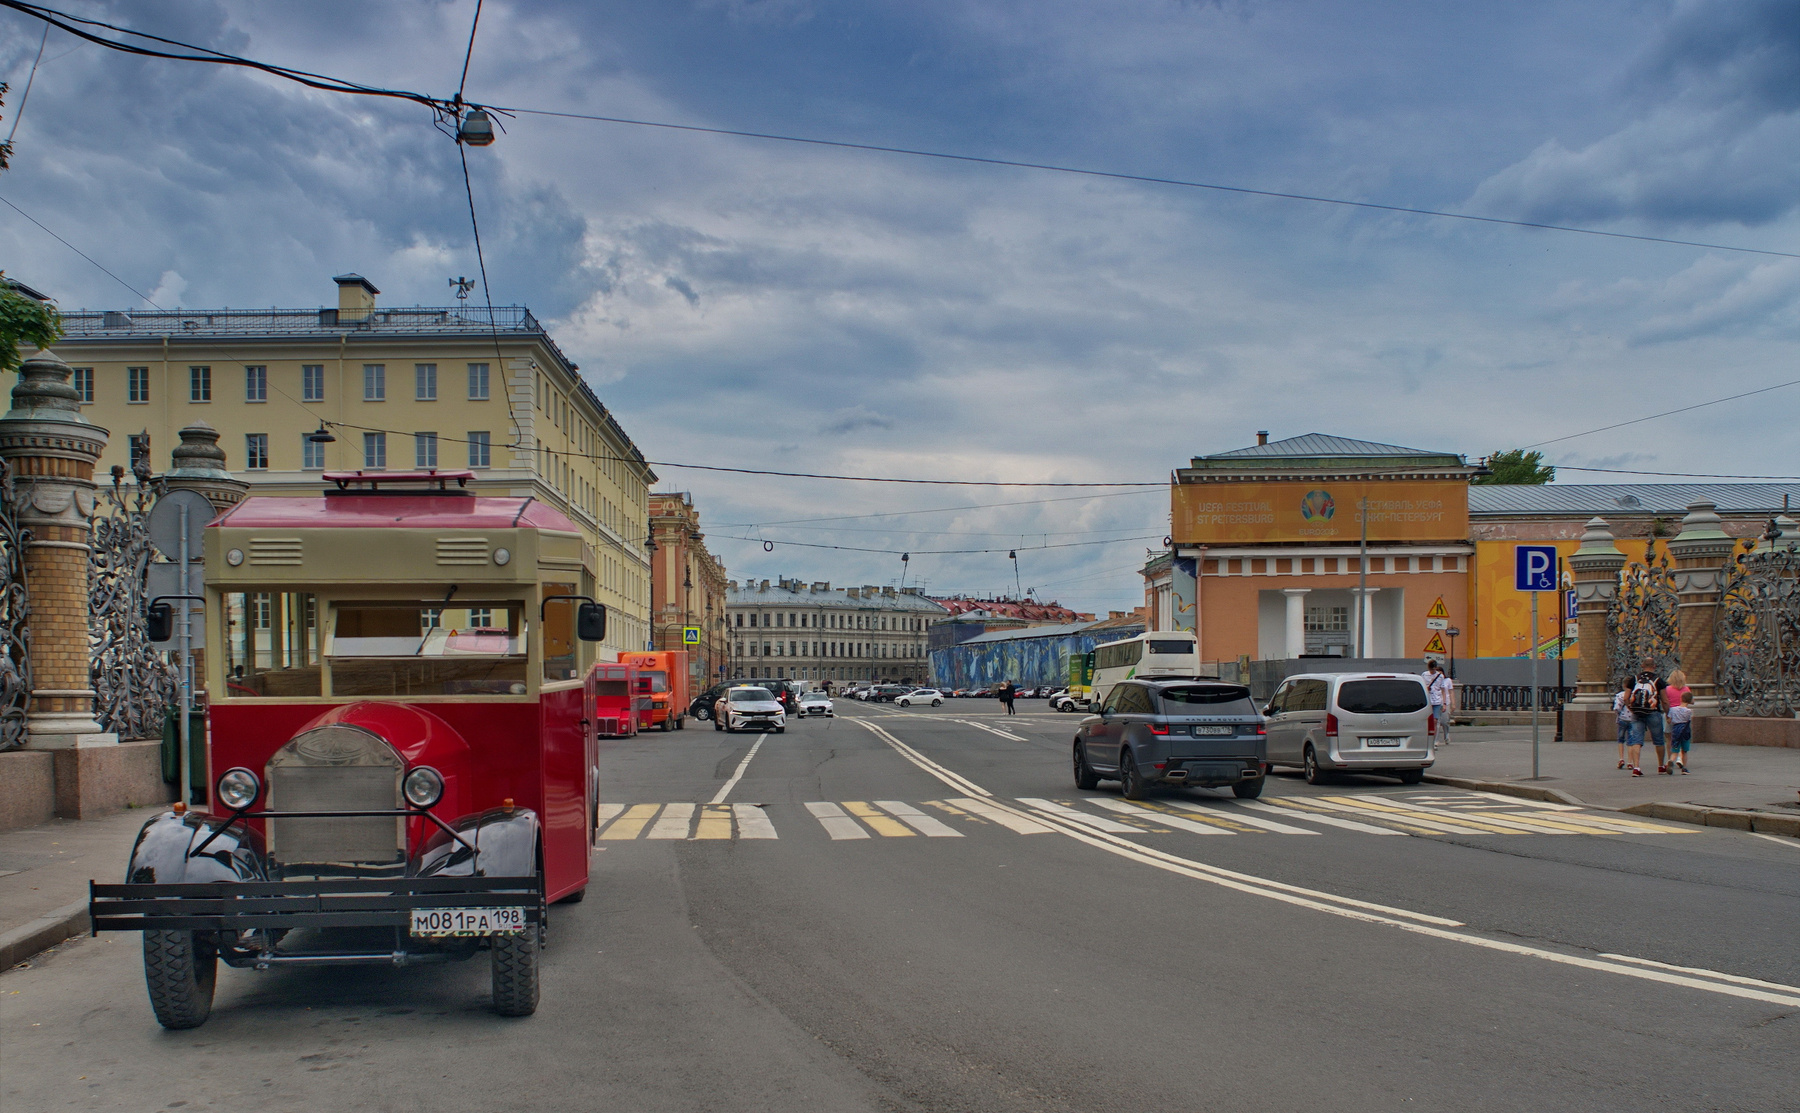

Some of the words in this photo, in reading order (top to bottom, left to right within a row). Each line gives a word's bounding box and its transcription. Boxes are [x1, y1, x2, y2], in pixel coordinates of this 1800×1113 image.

[1198, 502, 1223, 513] UEFA
[1225, 501, 1272, 512] FESTIVAL
[1415, 500, 1443, 510] УЕФА
[1197, 514, 1209, 525] ST
[1211, 513, 1275, 525] PETERSBURG
[1527, 551, 1550, 585] P
[630, 656, 656, 667] WC
[493, 910, 519, 924] 198
